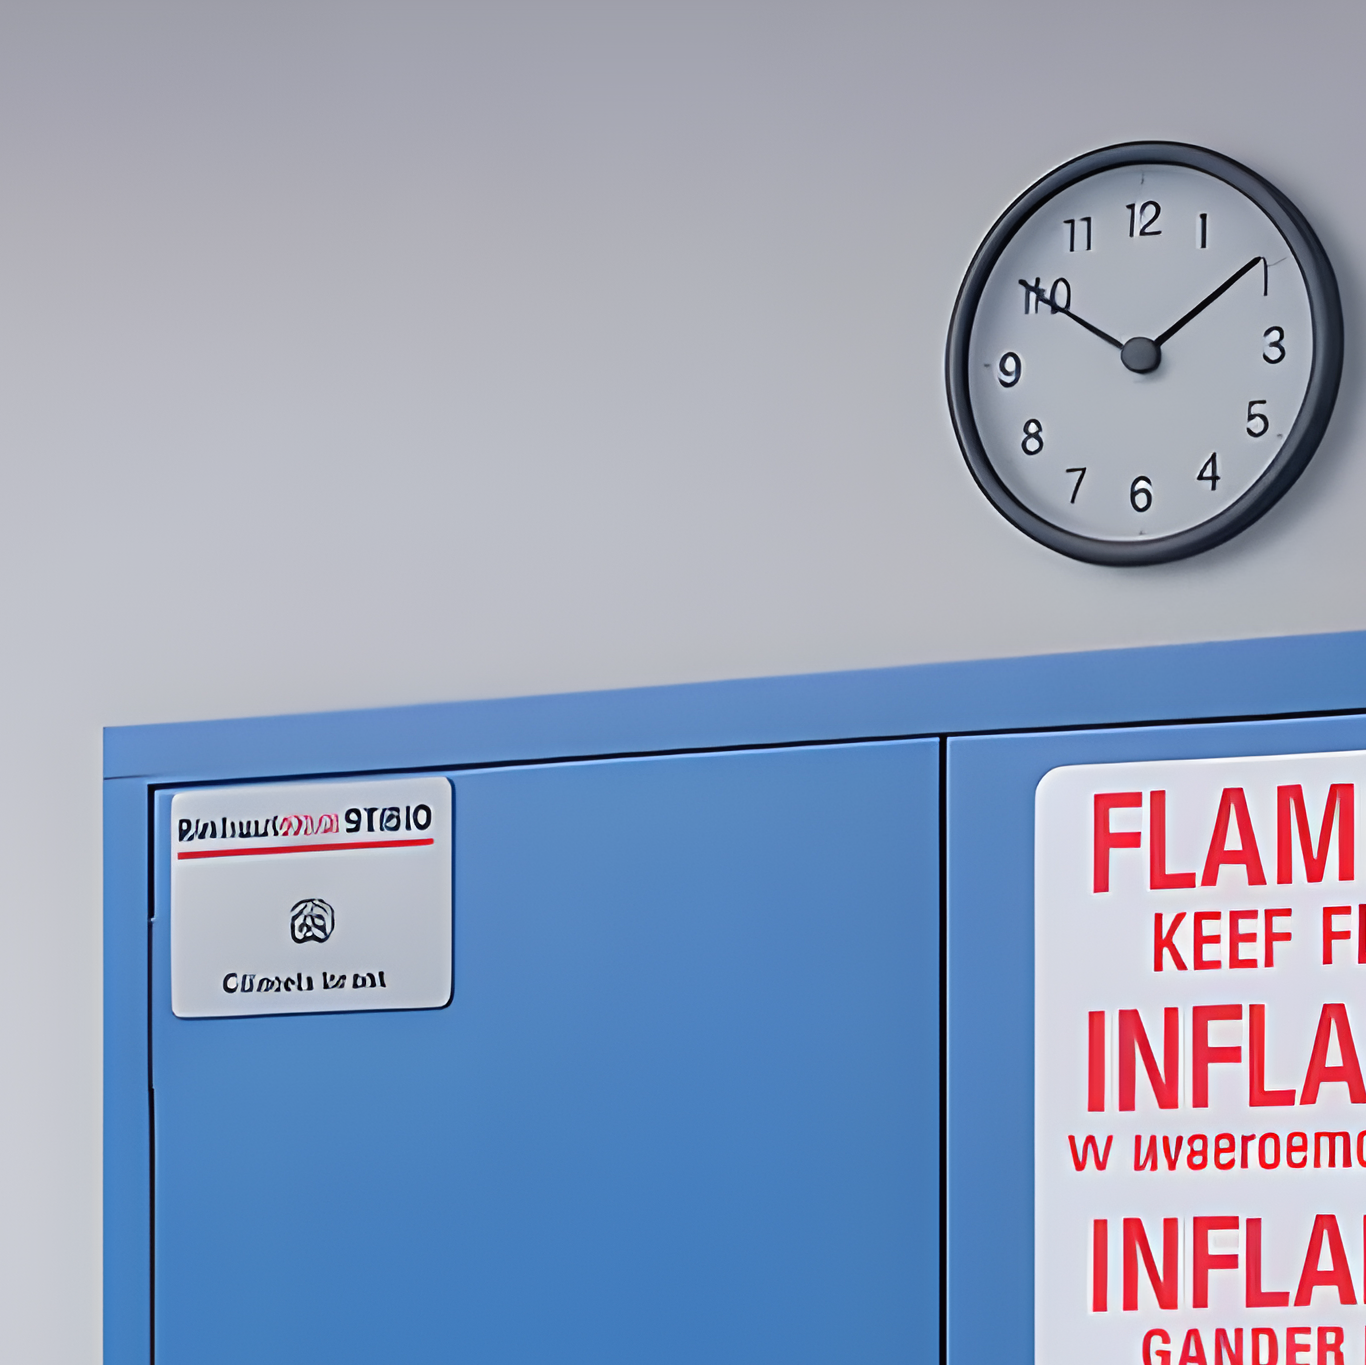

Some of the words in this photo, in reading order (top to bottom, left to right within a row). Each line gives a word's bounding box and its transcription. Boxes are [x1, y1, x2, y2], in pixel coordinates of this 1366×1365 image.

[1062, 216, 1092, 253] 11
[1125, 200, 1162, 238] 12
[1198, 212, 1209, 249] 1
[1262, 325, 1286, 365] 3
[997, 351, 1022, 389] 9
[1020, 418, 1044, 456] 8
[1246, 399, 1270, 438] 5
[1065, 466, 1087, 505] 7
[1196, 451, 1221, 492] 4
[1129, 475, 1153, 513] 6
[1153, 907, 1293, 973] KEEF
